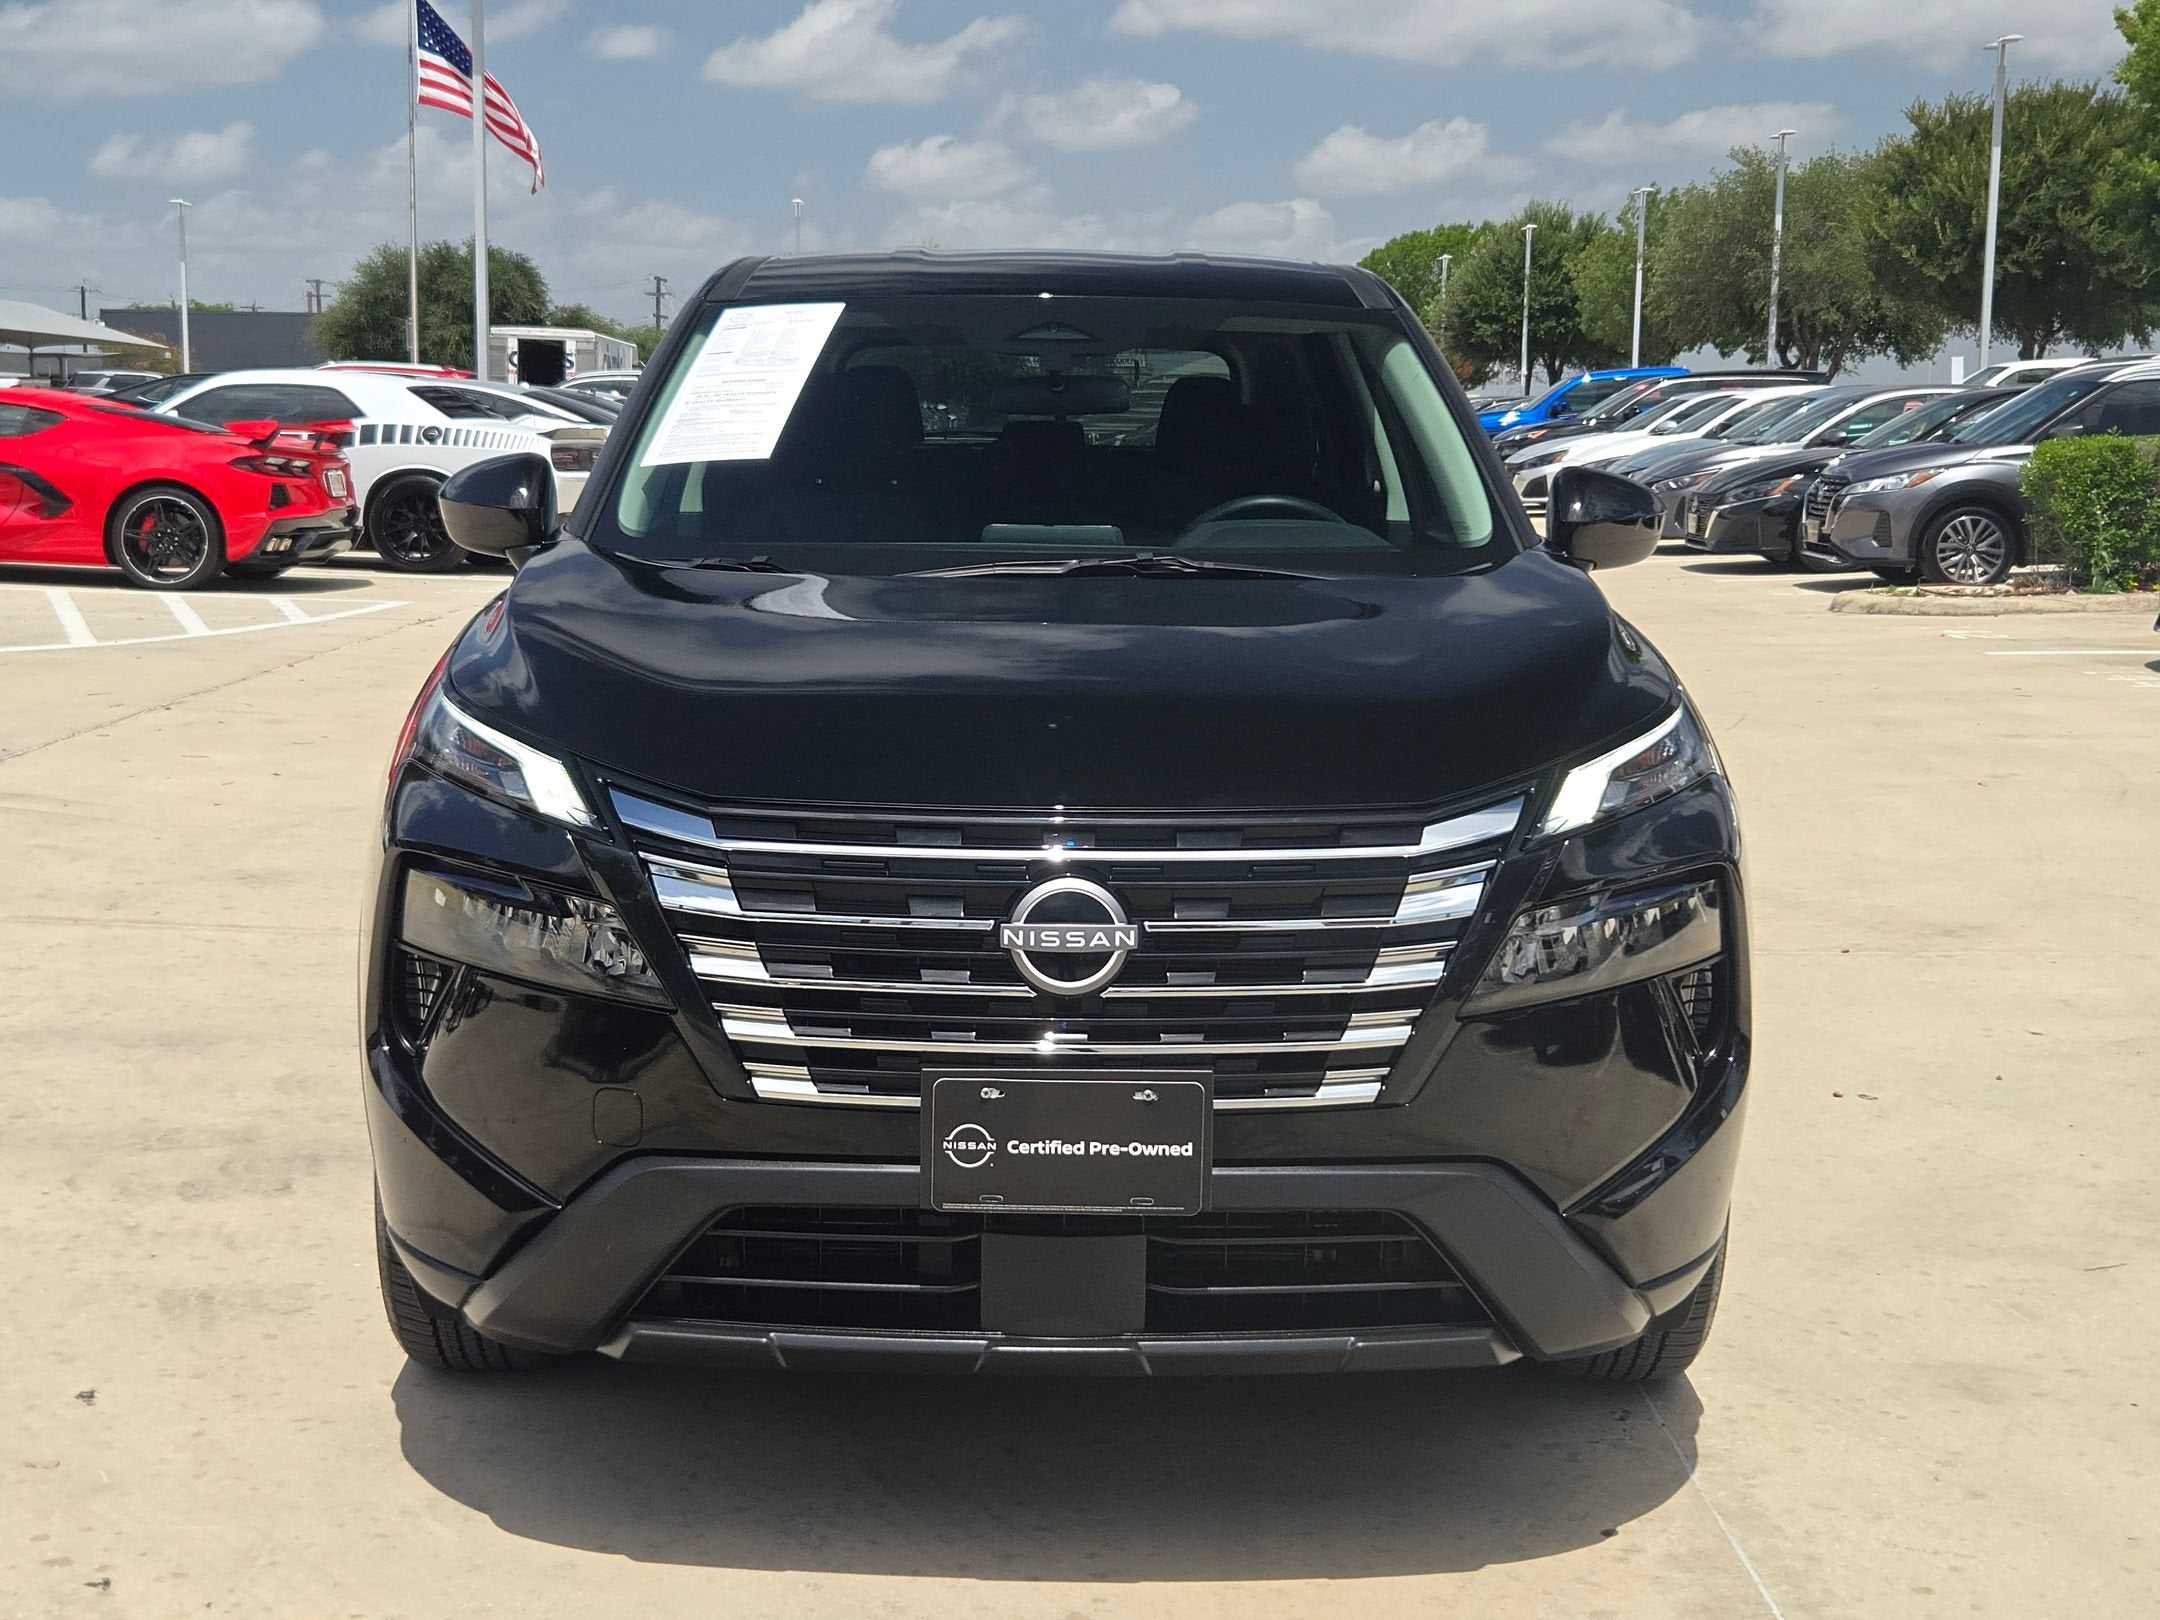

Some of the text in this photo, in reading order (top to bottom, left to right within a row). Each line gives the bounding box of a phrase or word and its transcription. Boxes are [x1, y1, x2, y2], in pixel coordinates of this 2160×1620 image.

[1003, 929, 1135, 947] NISSAN
[942, 1141, 997, 1151] NISSAN
[1006, 1139, 1193, 1157] Certified Pre-Owned
